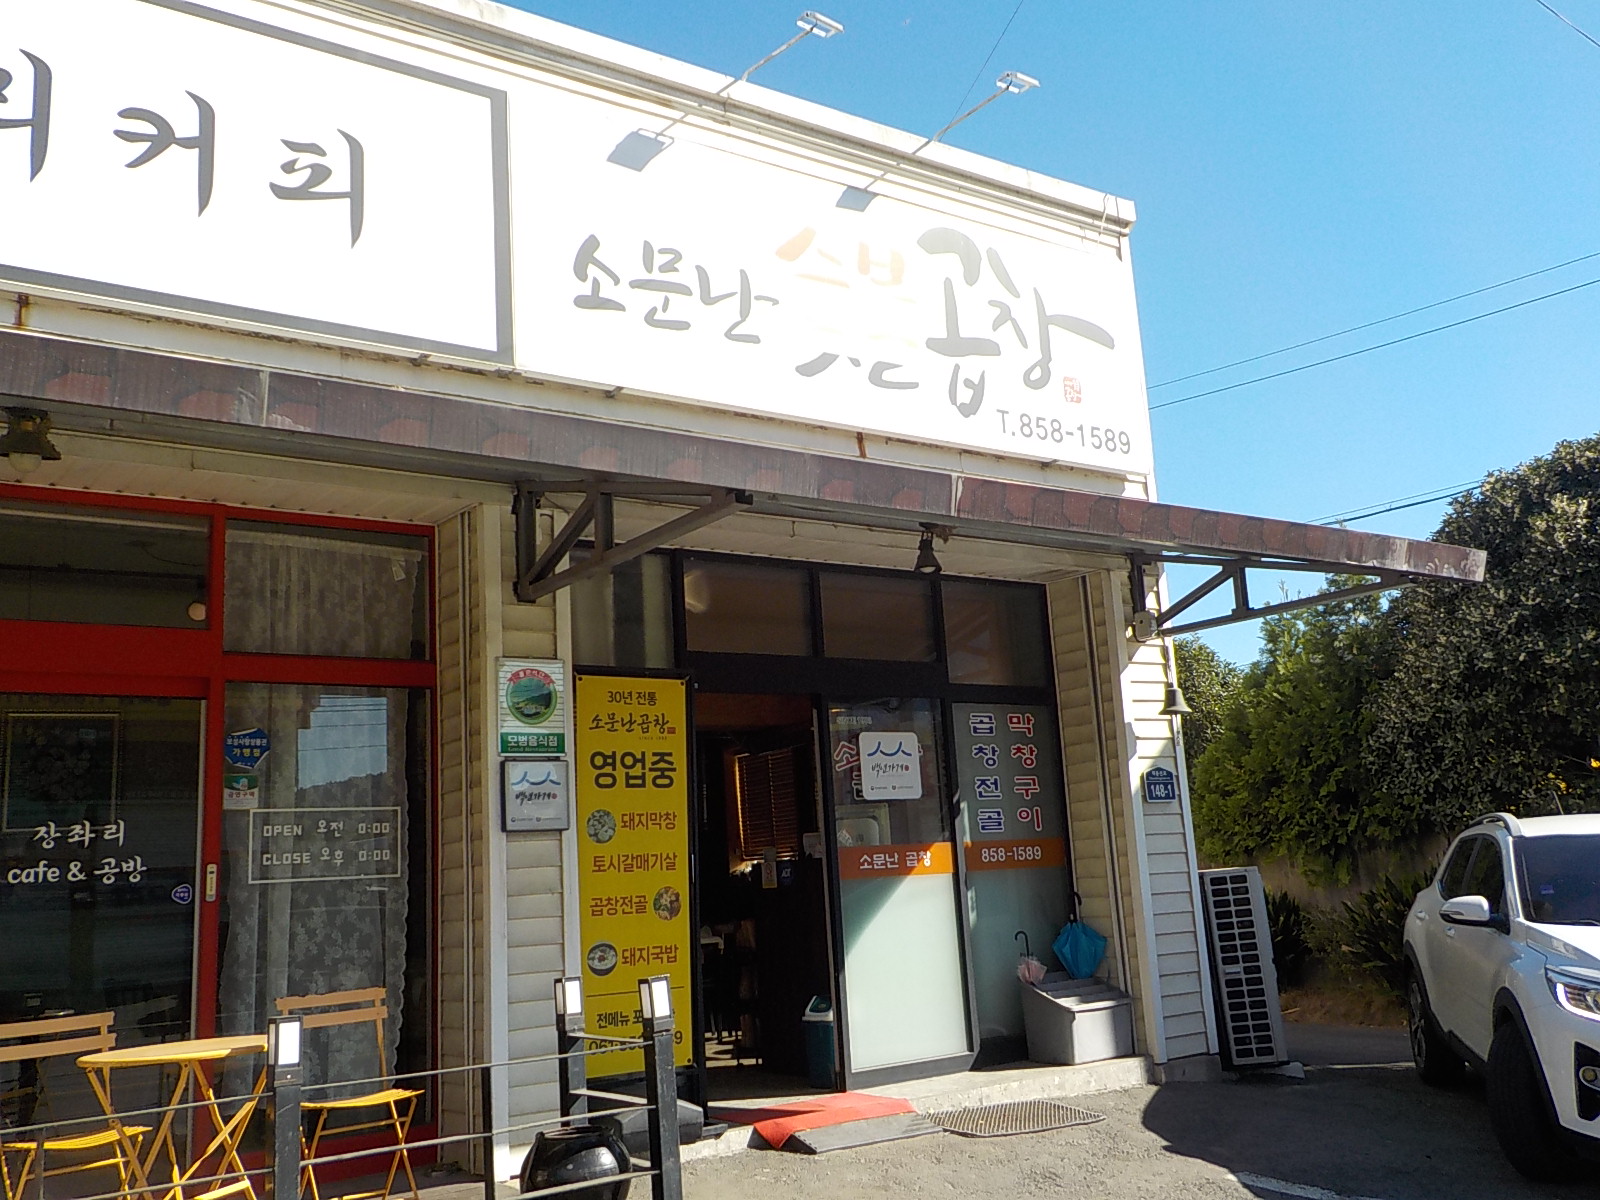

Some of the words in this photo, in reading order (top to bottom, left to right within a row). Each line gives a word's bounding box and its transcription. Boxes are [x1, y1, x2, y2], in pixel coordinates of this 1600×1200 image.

[573, 234, 780, 344] 소문난
[917, 226, 1115, 418] 곱창
[996, 408, 1132, 455] T.858-1589
[607, 690, 634, 706] 30년
[635, 691, 658, 706] 전통
[588, 712, 670, 735] 소문난곱창
[507, 735, 558, 747] 모범음식점
[589, 751, 677, 789] 영업중
[871, 762, 904, 779] 백년가게
[1150, 784, 1173, 798] 148-1
[263, 825, 303, 837] OPEN
[316, 820, 344, 838] 오전
[620, 811, 678, 831] 돼지막창
[33, 819, 125, 849] 장좌리
[262, 852, 311, 865] CLOSE
[320, 847, 344, 867] 오후
[591, 852, 678, 874] 토시갈매기살
[859, 852, 899, 870] 소문난
[905, 850, 932, 868] 곱창
[981, 846, 1042, 862] 858-1589
[8, 860, 60, 884] cafe
[67, 861, 87, 881] &
[93, 855, 147, 884] 공방
[589, 895, 649, 917] 곱창전골
[621, 943, 679, 966] 돼지국밥
[596, 1011, 631, 1029] 전메뉴
